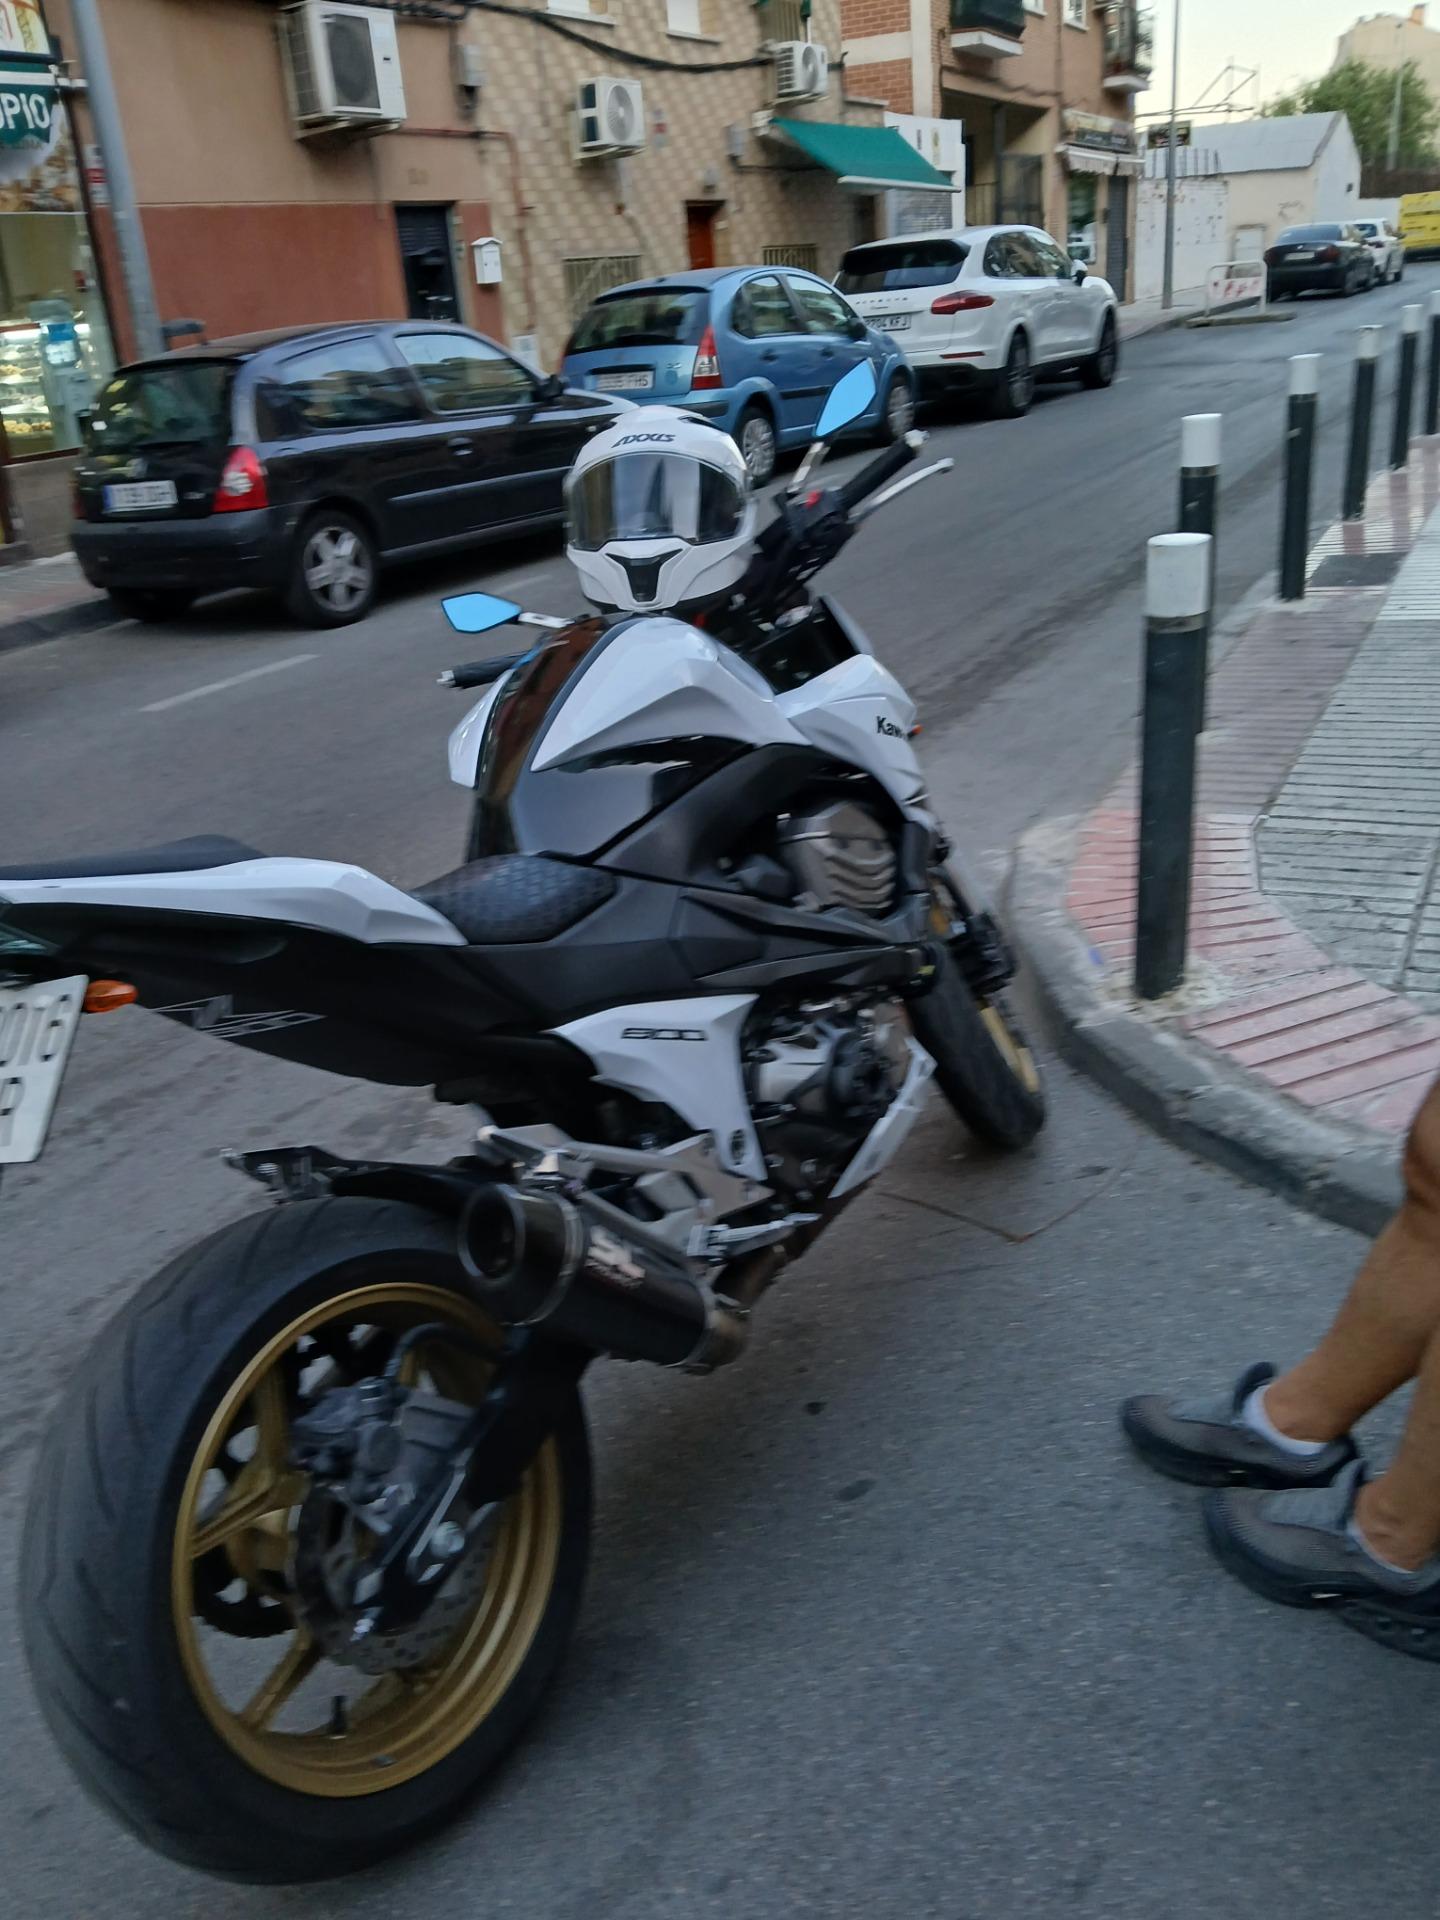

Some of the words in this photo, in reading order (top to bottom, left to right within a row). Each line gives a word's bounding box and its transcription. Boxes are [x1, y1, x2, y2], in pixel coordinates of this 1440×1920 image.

[0, 92, 51, 129] PIO
[876, 715, 906, 739] Kaw
[0, 993, 73, 1067] 016
[621, 1027, 709, 1042] 800
